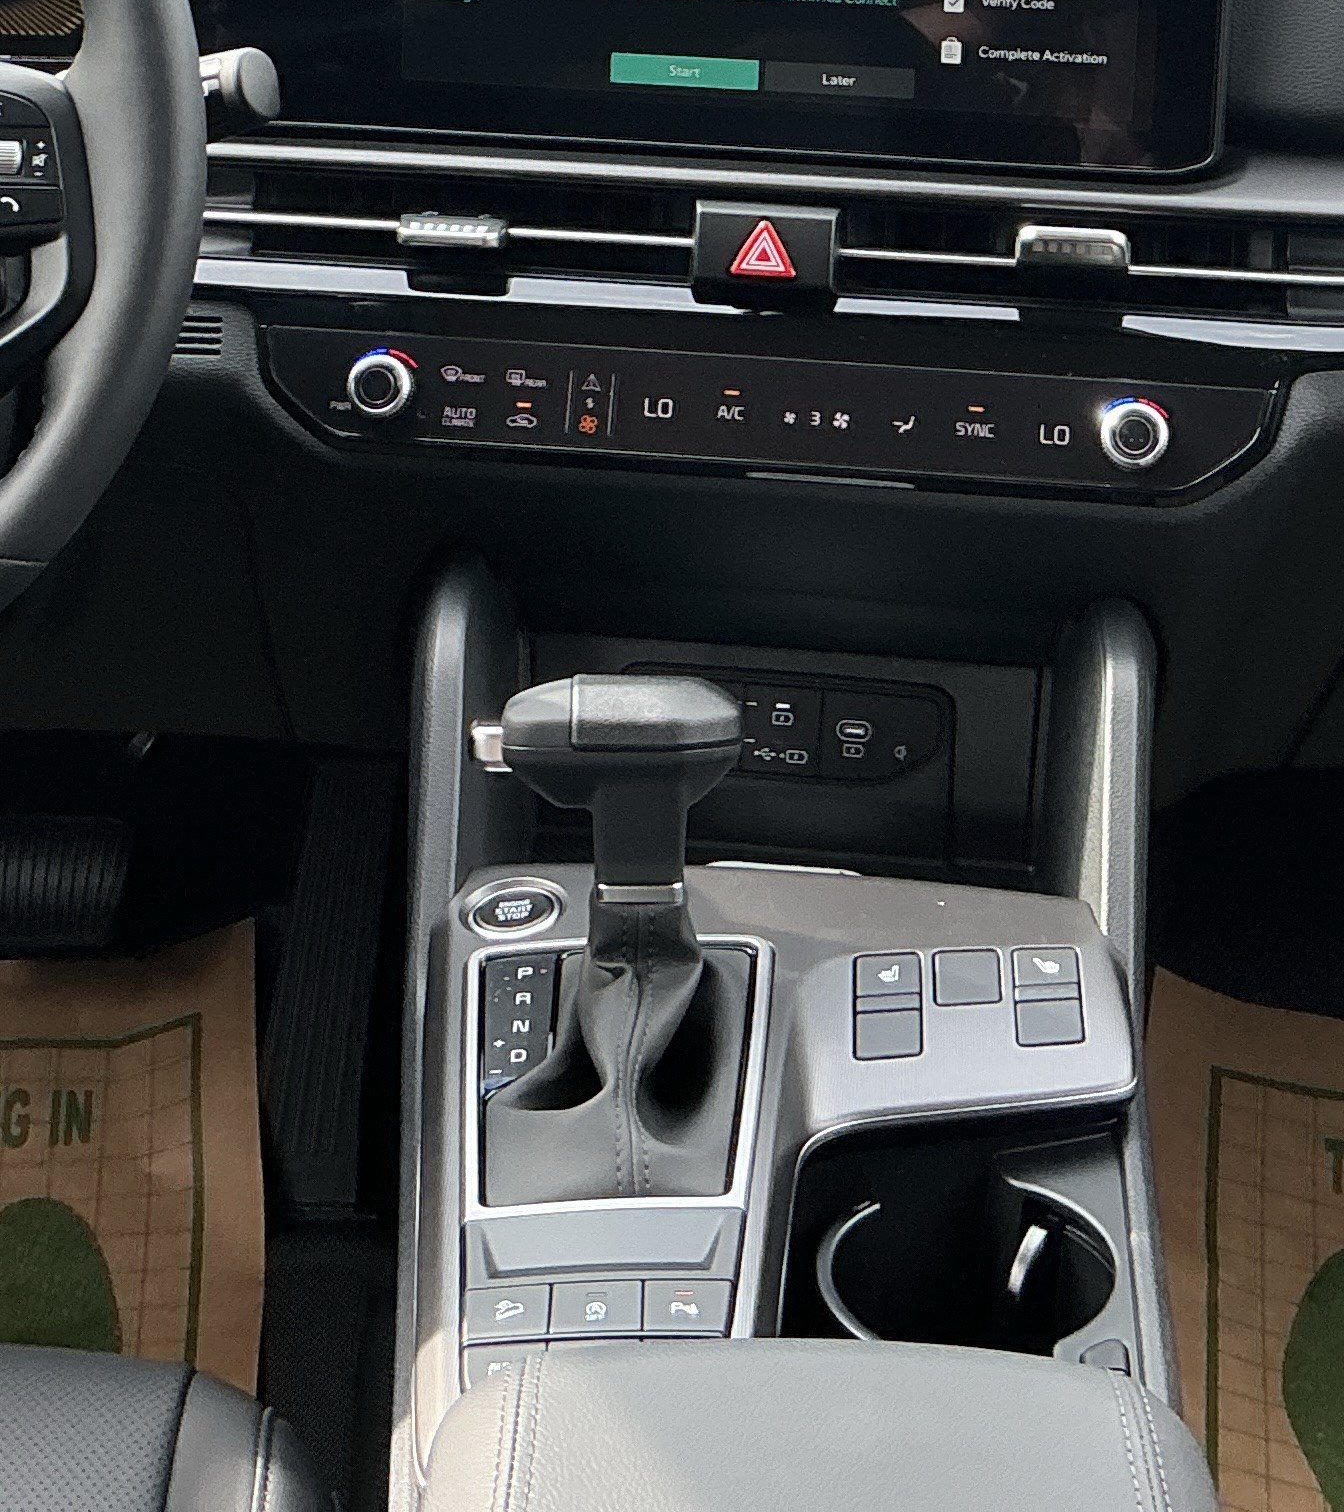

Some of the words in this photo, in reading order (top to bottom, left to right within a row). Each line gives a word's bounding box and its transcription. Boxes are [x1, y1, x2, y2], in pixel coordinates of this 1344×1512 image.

[978, 46, 1040, 62] Complete
[1042, 49, 1108, 65] Activation
[668, 63, 701, 79] Start
[821, 72, 856, 87] Later
[443, 405, 476, 419] AUTO
[644, 397, 674, 418] LO
[717, 404, 745, 421] A/C
[810, 411, 822, 426] 3
[955, 421, 995, 439] SYNC
[1040, 425, 1070, 446] LO
[495, 904, 533, 916] START
[498, 912, 529, 921] STOP
[516, 967, 533, 981] P
[512, 1019, 530, 1034] N
[509, 1047, 527, 1063] D
[45, 1088, 95, 1147] IN
